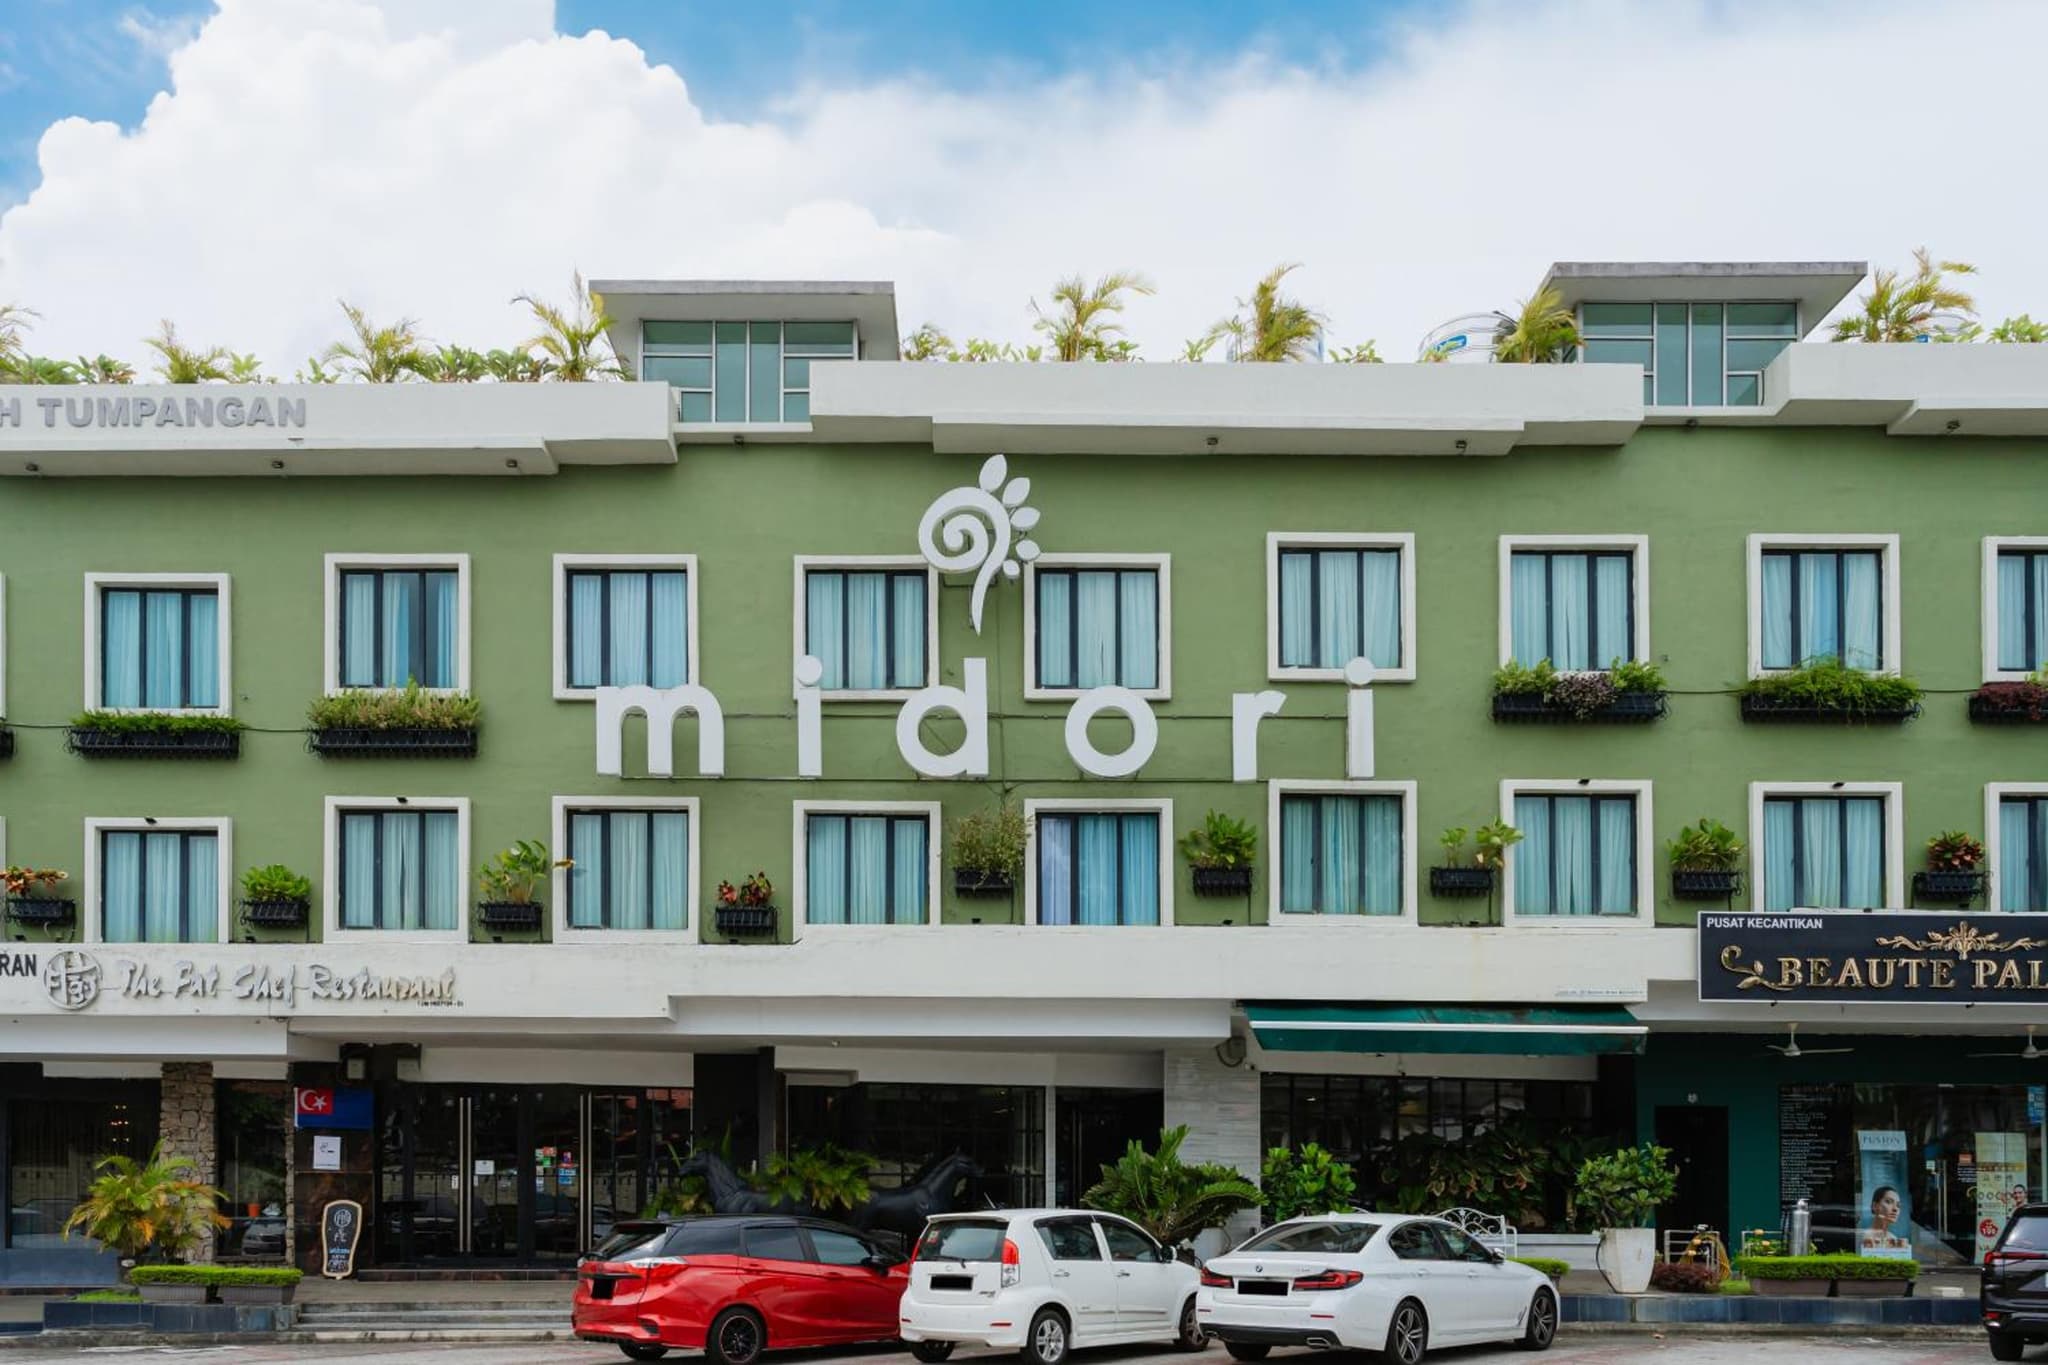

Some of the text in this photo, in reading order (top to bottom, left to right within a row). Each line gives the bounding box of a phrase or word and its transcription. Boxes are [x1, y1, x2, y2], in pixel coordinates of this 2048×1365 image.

[0, 397, 306, 428] H TUMPANGAN
[596, 656, 1376, 782] midori
[1706, 917, 1823, 929] PUSAT KECANTIKAN
[0, 954, 37, 977] RAN
[116, 959, 163, 999] The
[175, 959, 221, 999] Fat
[308, 963, 456, 1001] Restaurant
[1777, 957, 2048, 989] BEAUTE PAL
